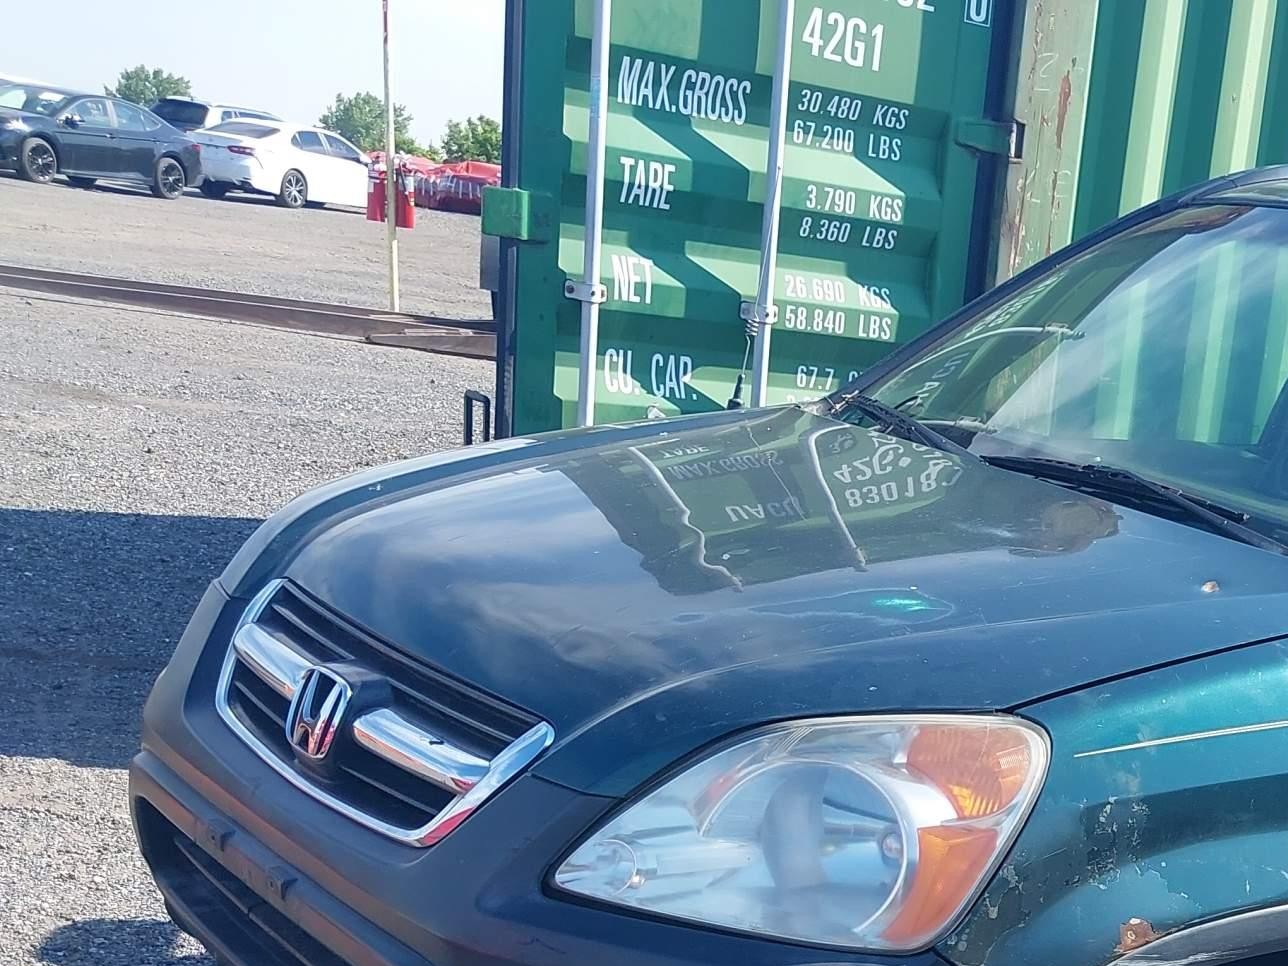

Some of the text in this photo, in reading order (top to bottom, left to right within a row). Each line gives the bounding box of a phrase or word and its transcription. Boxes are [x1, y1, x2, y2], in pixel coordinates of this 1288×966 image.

[802, 7, 884, 72] 42G1
[798, 89, 909, 130] 30.480 KGS
[793, 119, 902, 161] 67.200 LBS
[619, 156, 676, 210] TARE
[806, 184, 903, 222] 3.790 KGS
[800, 216, 897, 249] 8.360 LBS
[611, 254, 653, 304] NET
[784, 274, 891, 309] 26.690 KGS
[858, 314, 891, 340] LBS
[604, 348, 697, 401] CU. CAP.
[796, 365, 835, 391] 67.7
